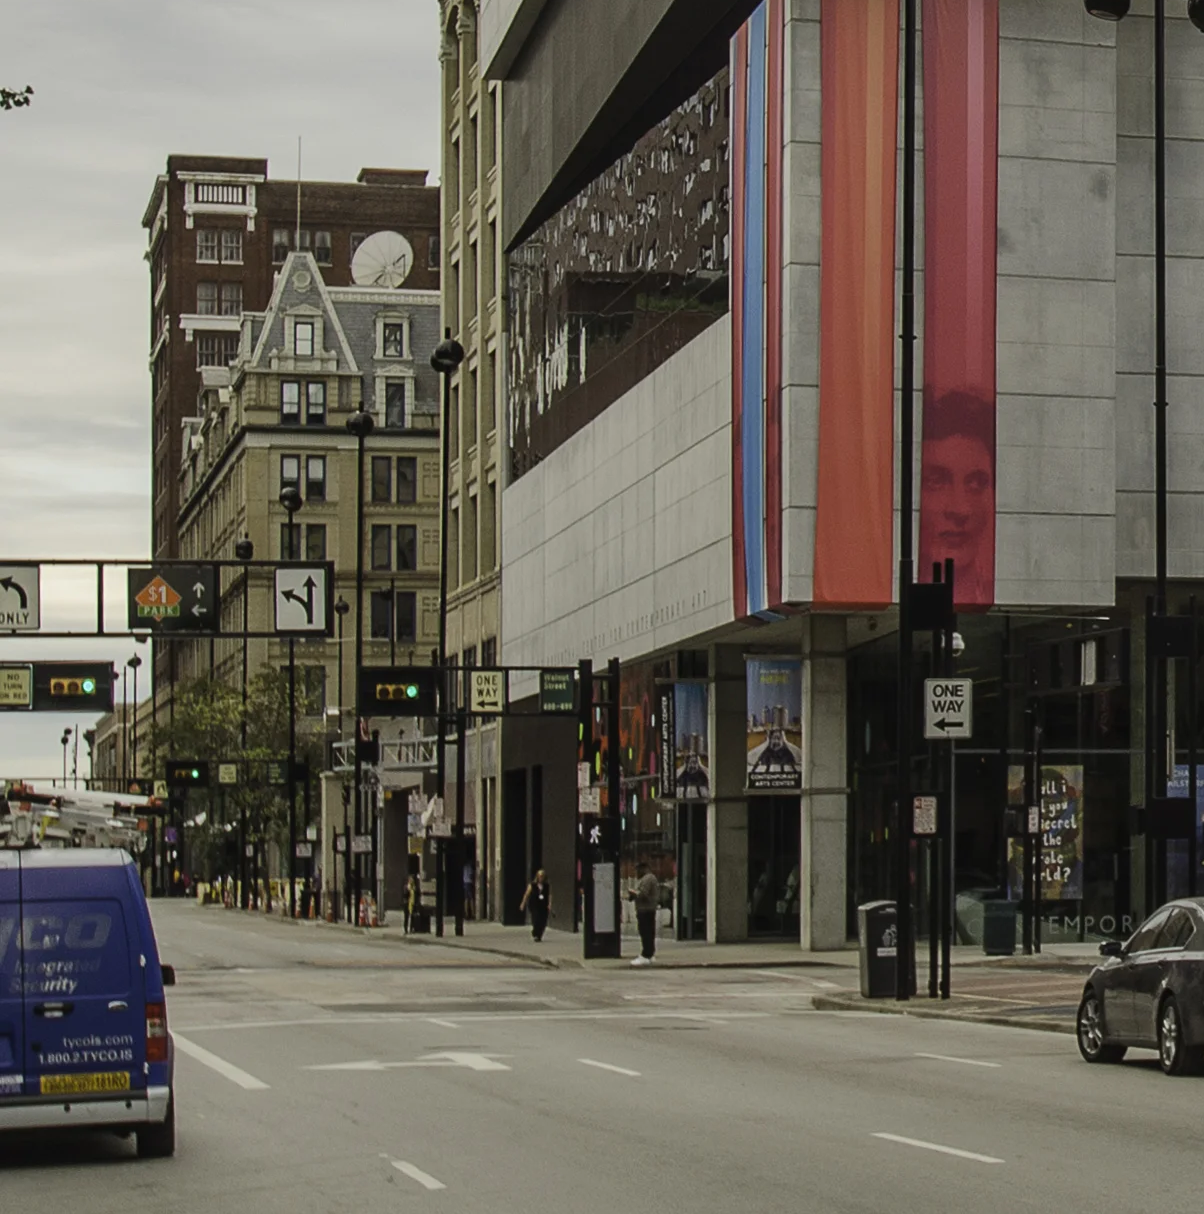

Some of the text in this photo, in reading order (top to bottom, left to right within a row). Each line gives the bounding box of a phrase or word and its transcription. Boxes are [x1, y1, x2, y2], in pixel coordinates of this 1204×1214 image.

[148, 585, 167, 603] $1
[143, 607, 174, 615] PARK
[0, 613, 29, 625] ONLY
[7, 673, 20, 681] NO
[476, 675, 498, 686] ONE
[3, 682, 23, 691] TURN
[932, 684, 964, 698] ONE
[13, 692, 28, 700] RED
[476, 688, 498, 698] WAY
[932, 699, 964, 713] WAY
[1049, 801, 1068, 817] you
